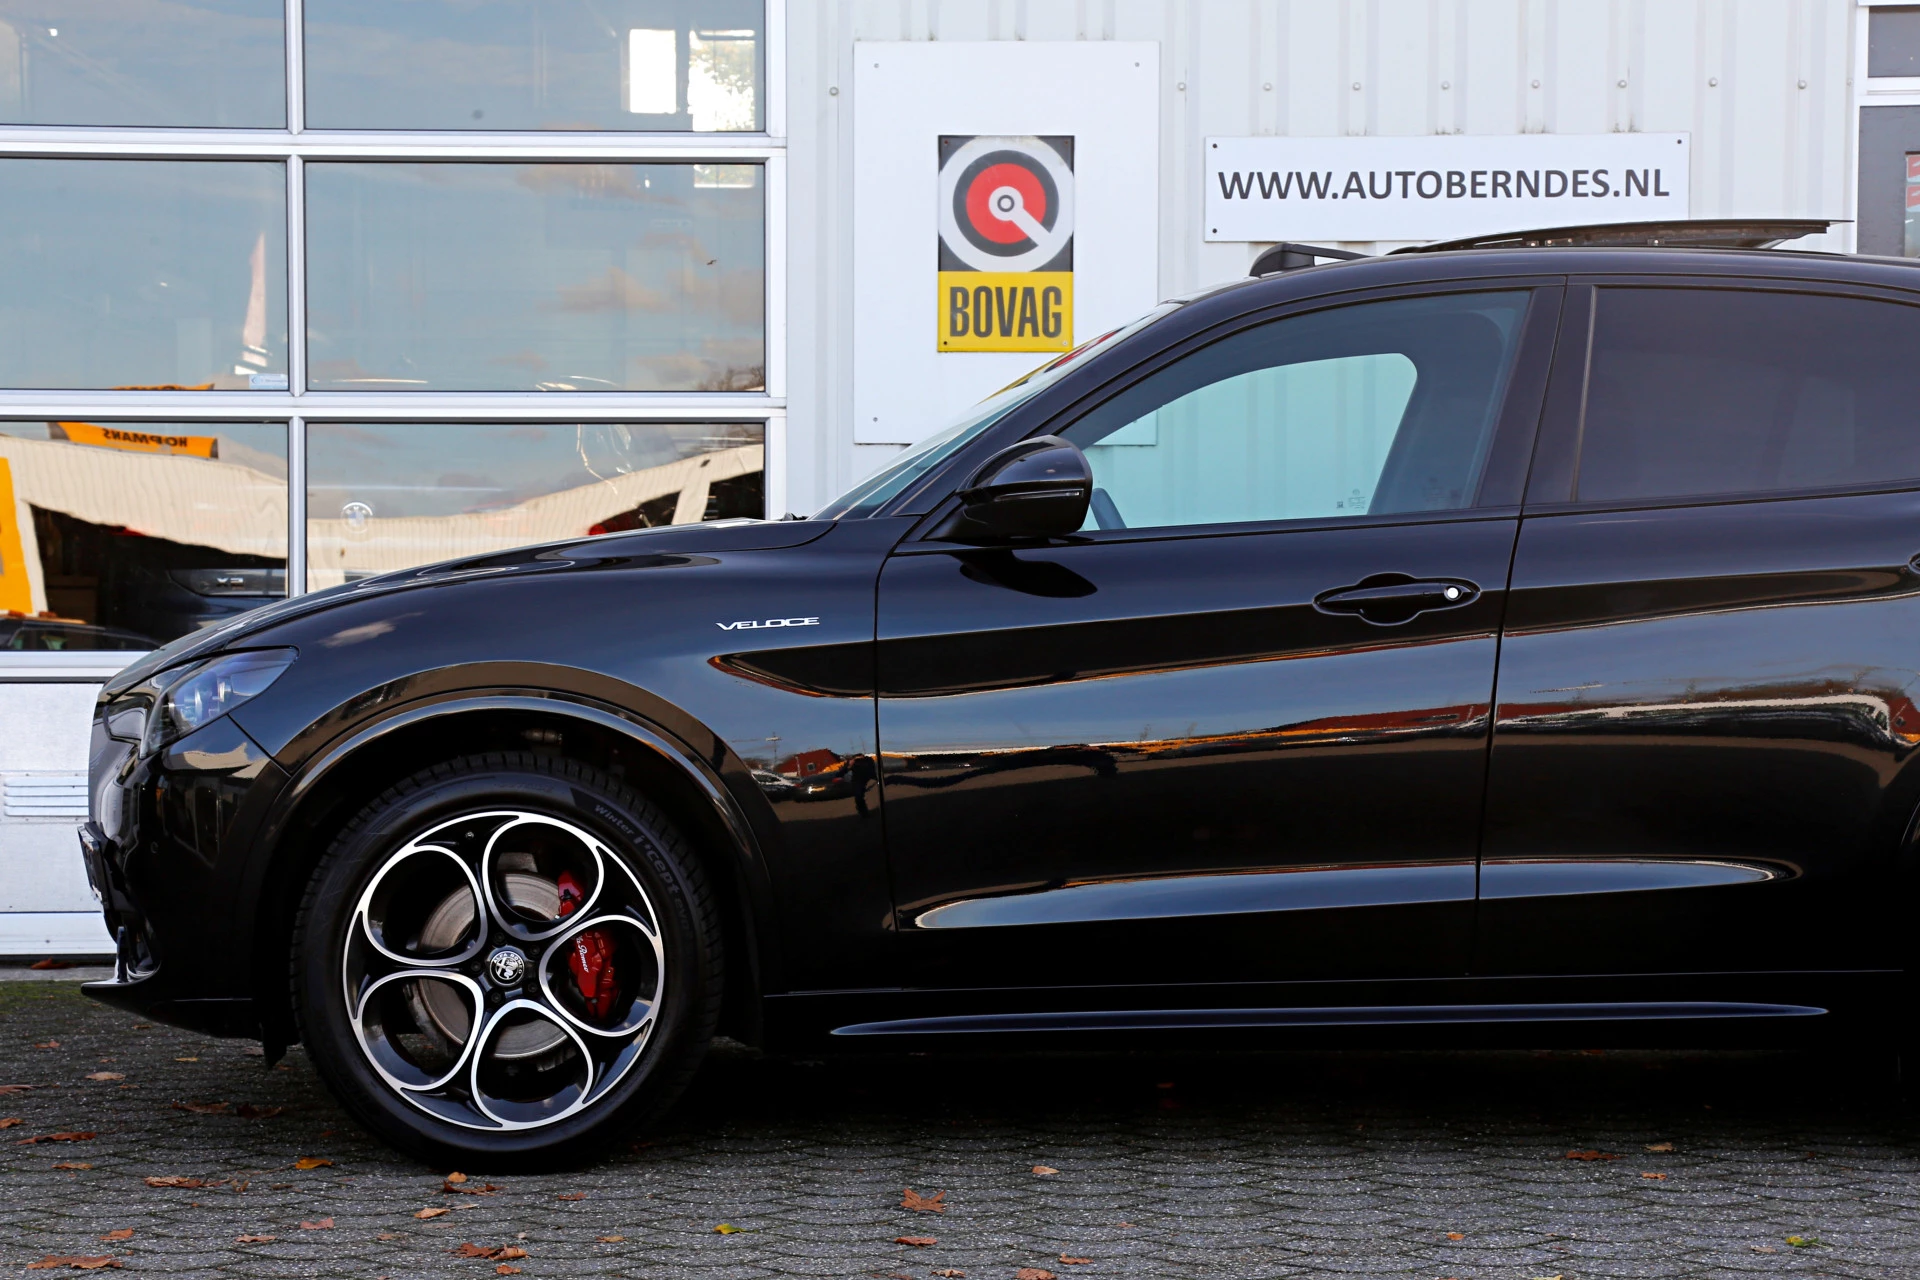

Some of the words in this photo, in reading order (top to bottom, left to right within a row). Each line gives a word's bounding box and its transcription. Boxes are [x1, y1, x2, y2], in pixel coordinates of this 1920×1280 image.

[1217, 168, 1670, 200] WWW.AUTOBERNDES.NL
[949, 285, 1063, 338] BOVAG
[715, 616, 820, 631] VELOCE
